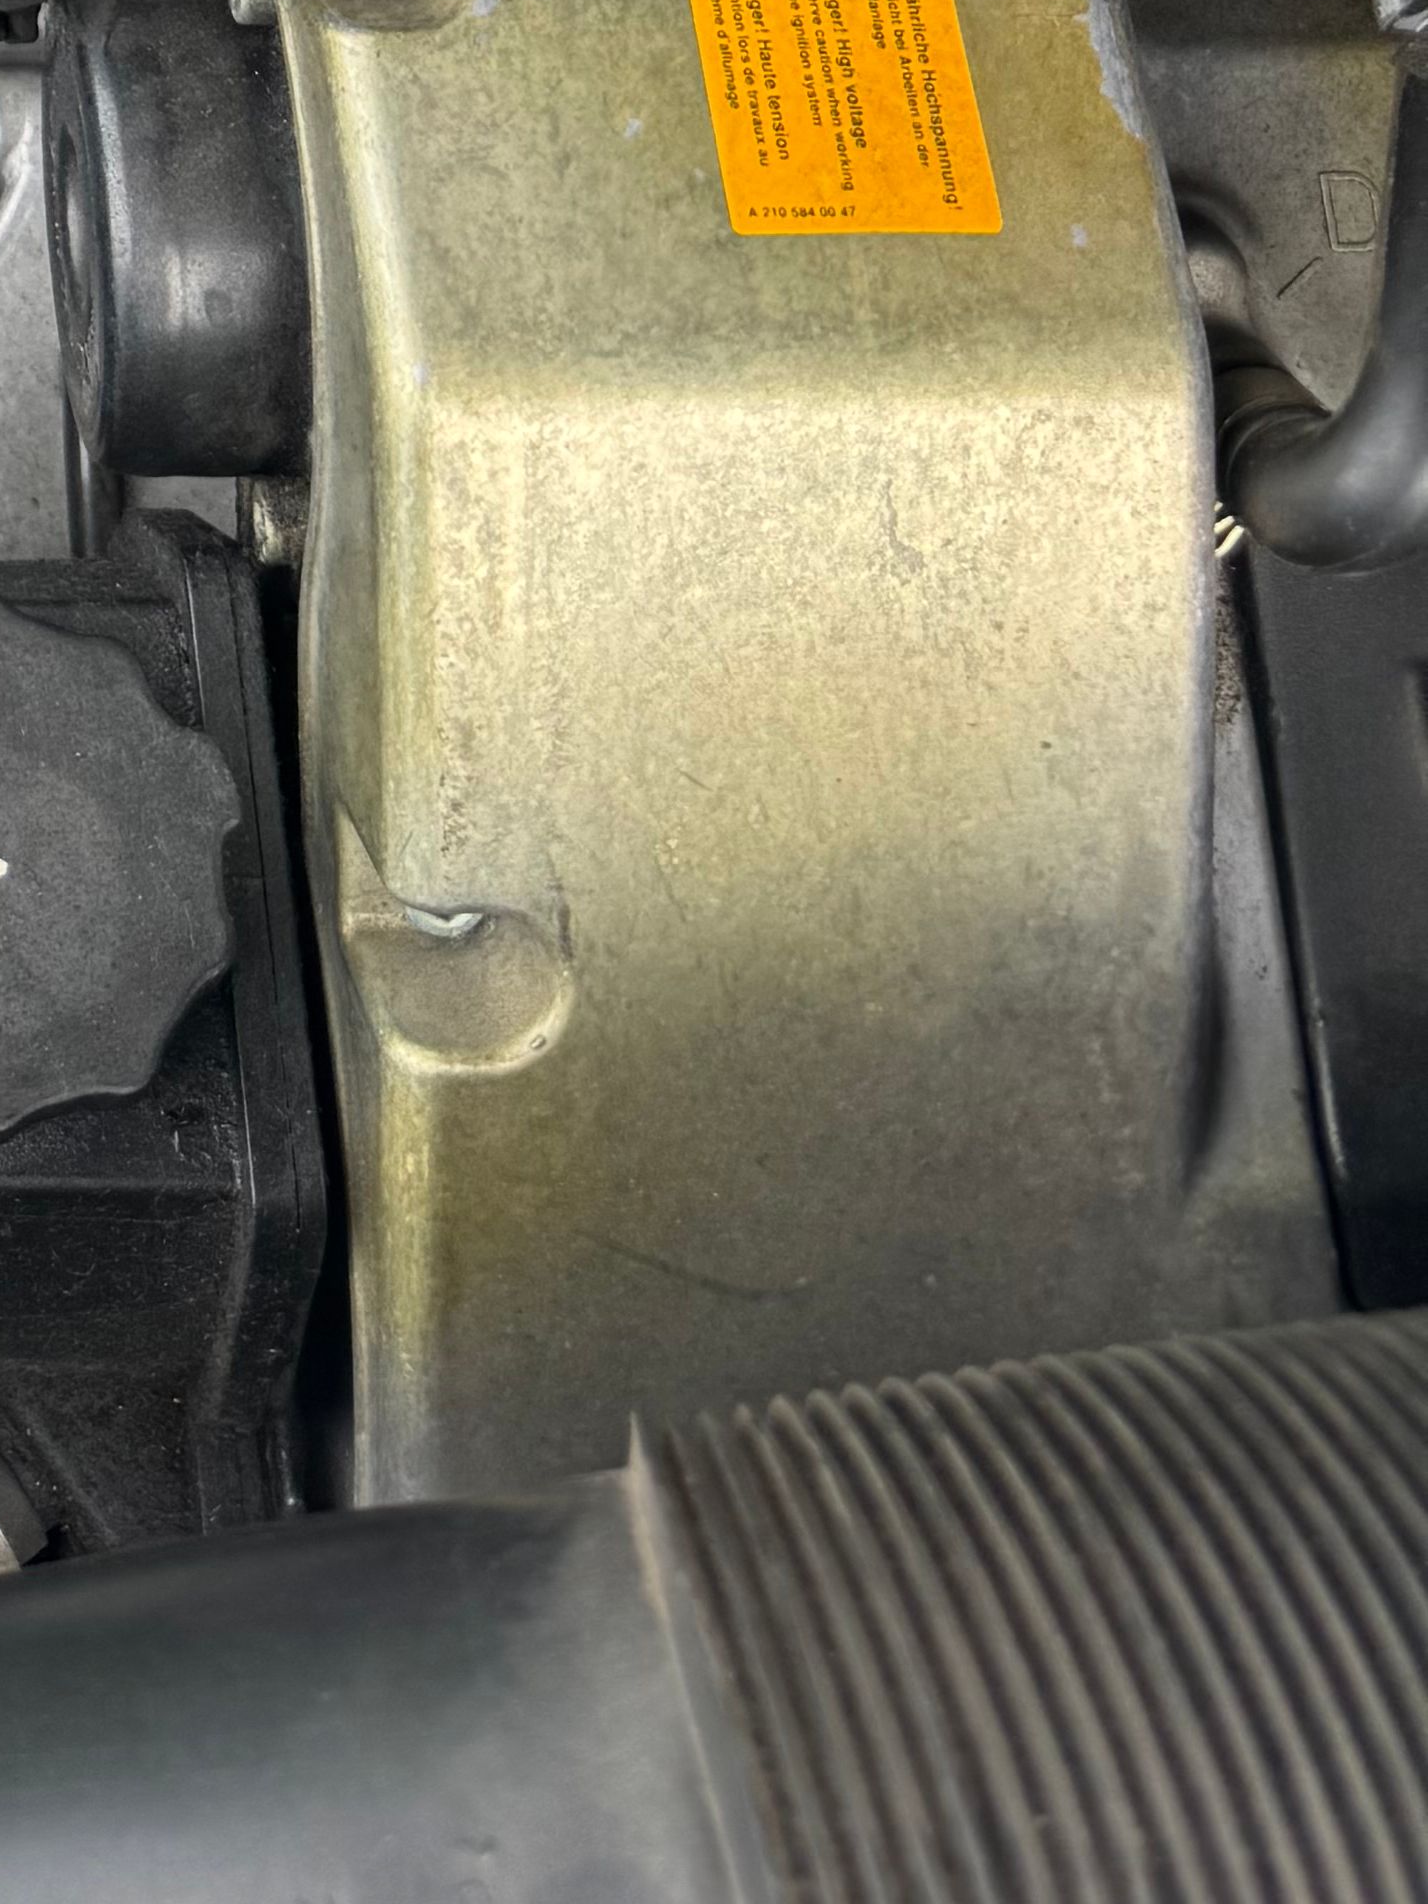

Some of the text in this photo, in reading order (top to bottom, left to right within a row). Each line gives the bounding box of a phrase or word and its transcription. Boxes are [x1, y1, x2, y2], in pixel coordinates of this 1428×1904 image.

[737, 35, 753, 64] lors
[756, 40, 780, 90] Haute
[894, 29, 906, 51] bei
[743, 68, 758, 86] de
[790, 14, 813, 69] ignition
[804, 74, 823, 127] system
[834, 39, 856, 78] High
[846, 85, 868, 149] voltage
[898, 56, 919, 118] Arbeiten
[747, 90, 766, 145] travaux
[767, 95, 791, 160] tension
[814, 30, 834, 84] caution
[826, 88, 842, 127] when
[834, 132, 854, 192] working
[911, 121, 923, 140] an
[758, 149, 770, 167] au
[916, 144, 931, 168] der
[920, 70, 964, 212] Hochspannung!
[748, 205, 856, 218] A 210 584 00 47
